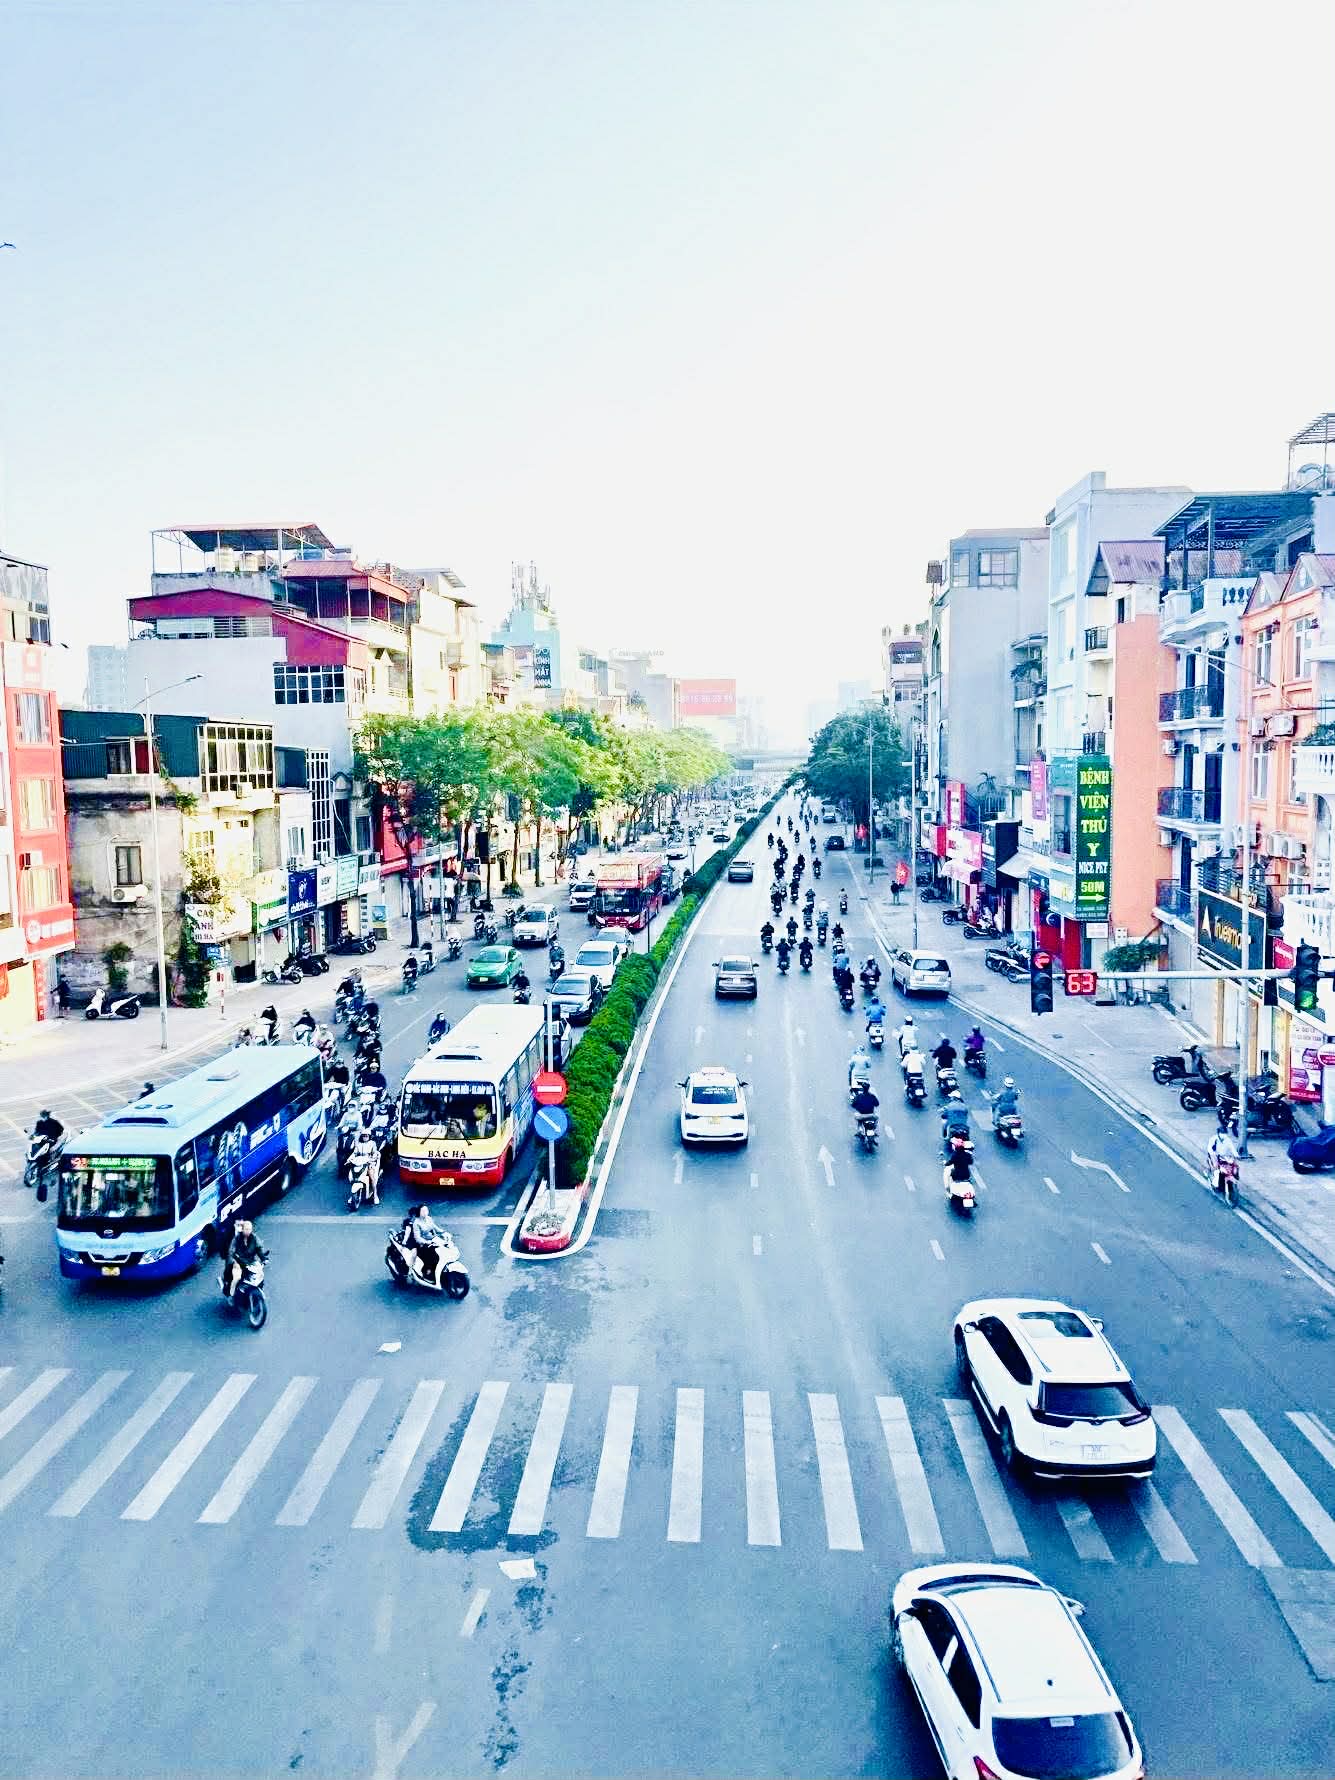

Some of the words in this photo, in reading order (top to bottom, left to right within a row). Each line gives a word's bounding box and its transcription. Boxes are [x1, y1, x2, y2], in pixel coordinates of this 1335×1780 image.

[1079, 767, 1110, 788] BỆNH
[1079, 791, 1110, 813] VIỆN
[1080, 815, 1107, 834] THÚ
[1087, 842, 1100, 857] Y
[1078, 861, 1094, 874] NICE
[1095, 861, 1109, 874] PET
[1081, 881, 1105, 893] 50M
[1067, 973, 1094, 993] 63
